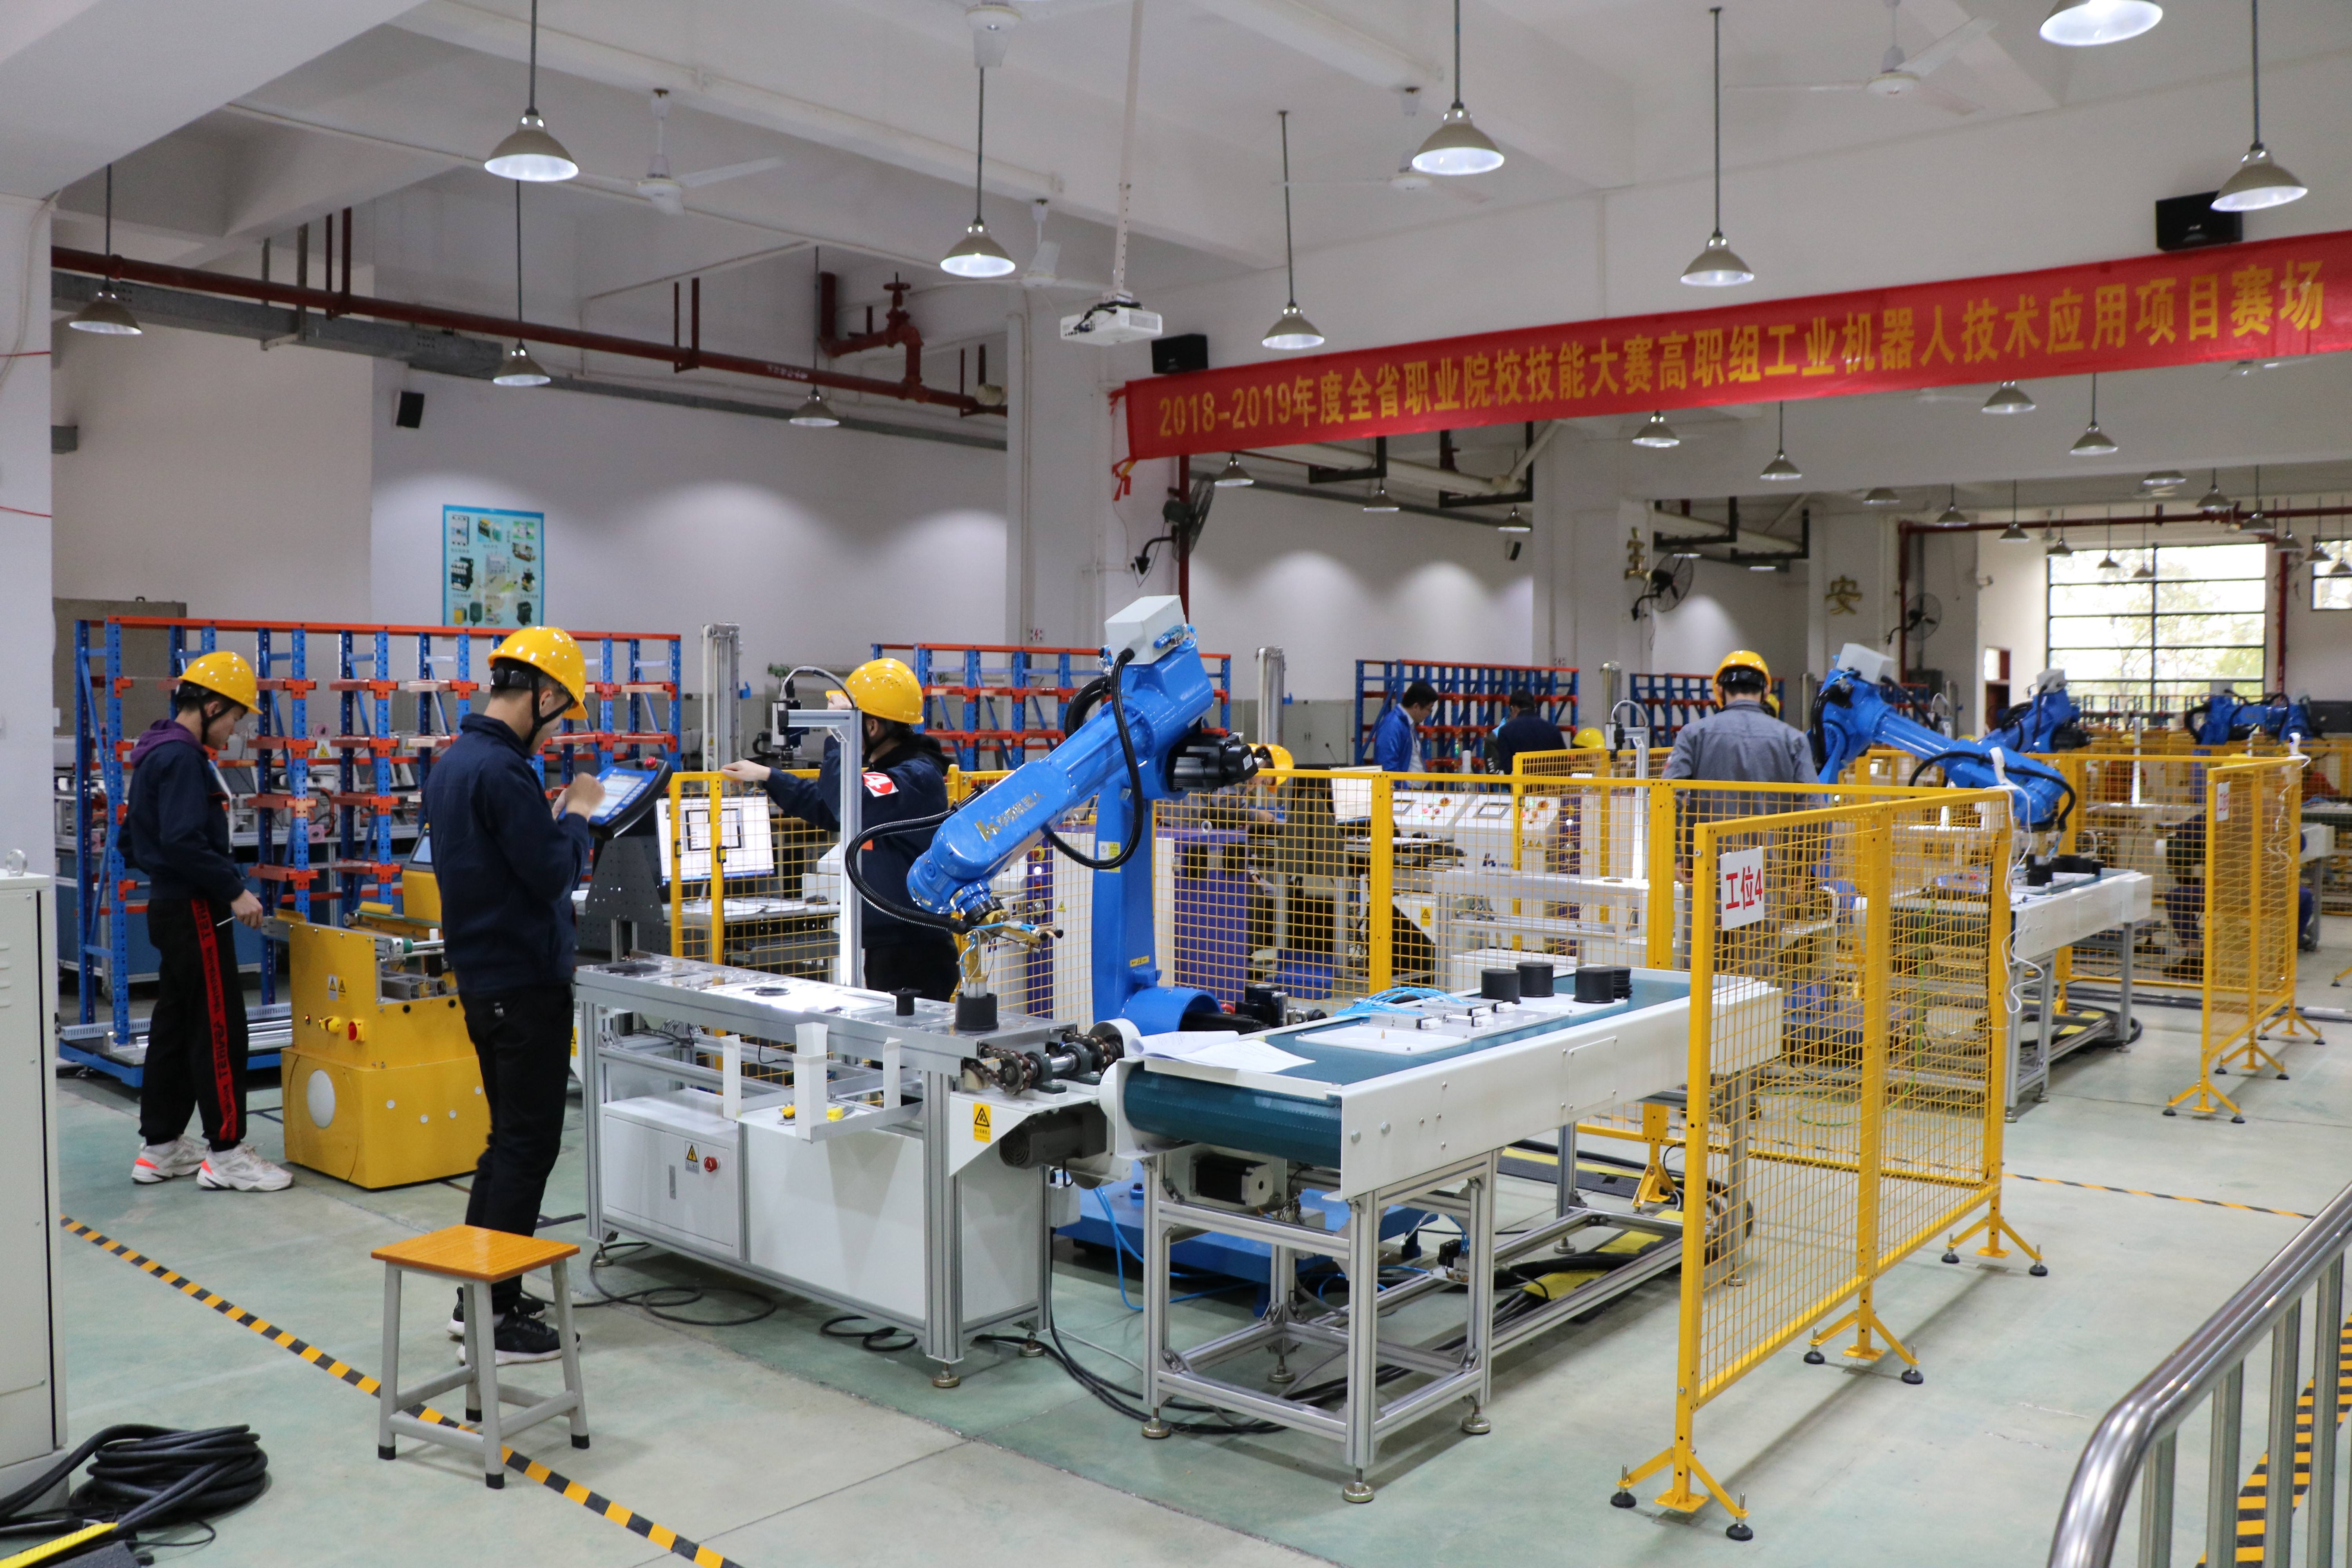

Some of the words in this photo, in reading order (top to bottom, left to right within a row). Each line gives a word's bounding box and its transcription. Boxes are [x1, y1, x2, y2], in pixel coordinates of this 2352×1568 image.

[1158, 260, 2325, 438] 2018-2019年度全省职业院校技能大赛高职组工业机器人技术应用项目赛场
[1726, 866, 1762, 910] 工位4
